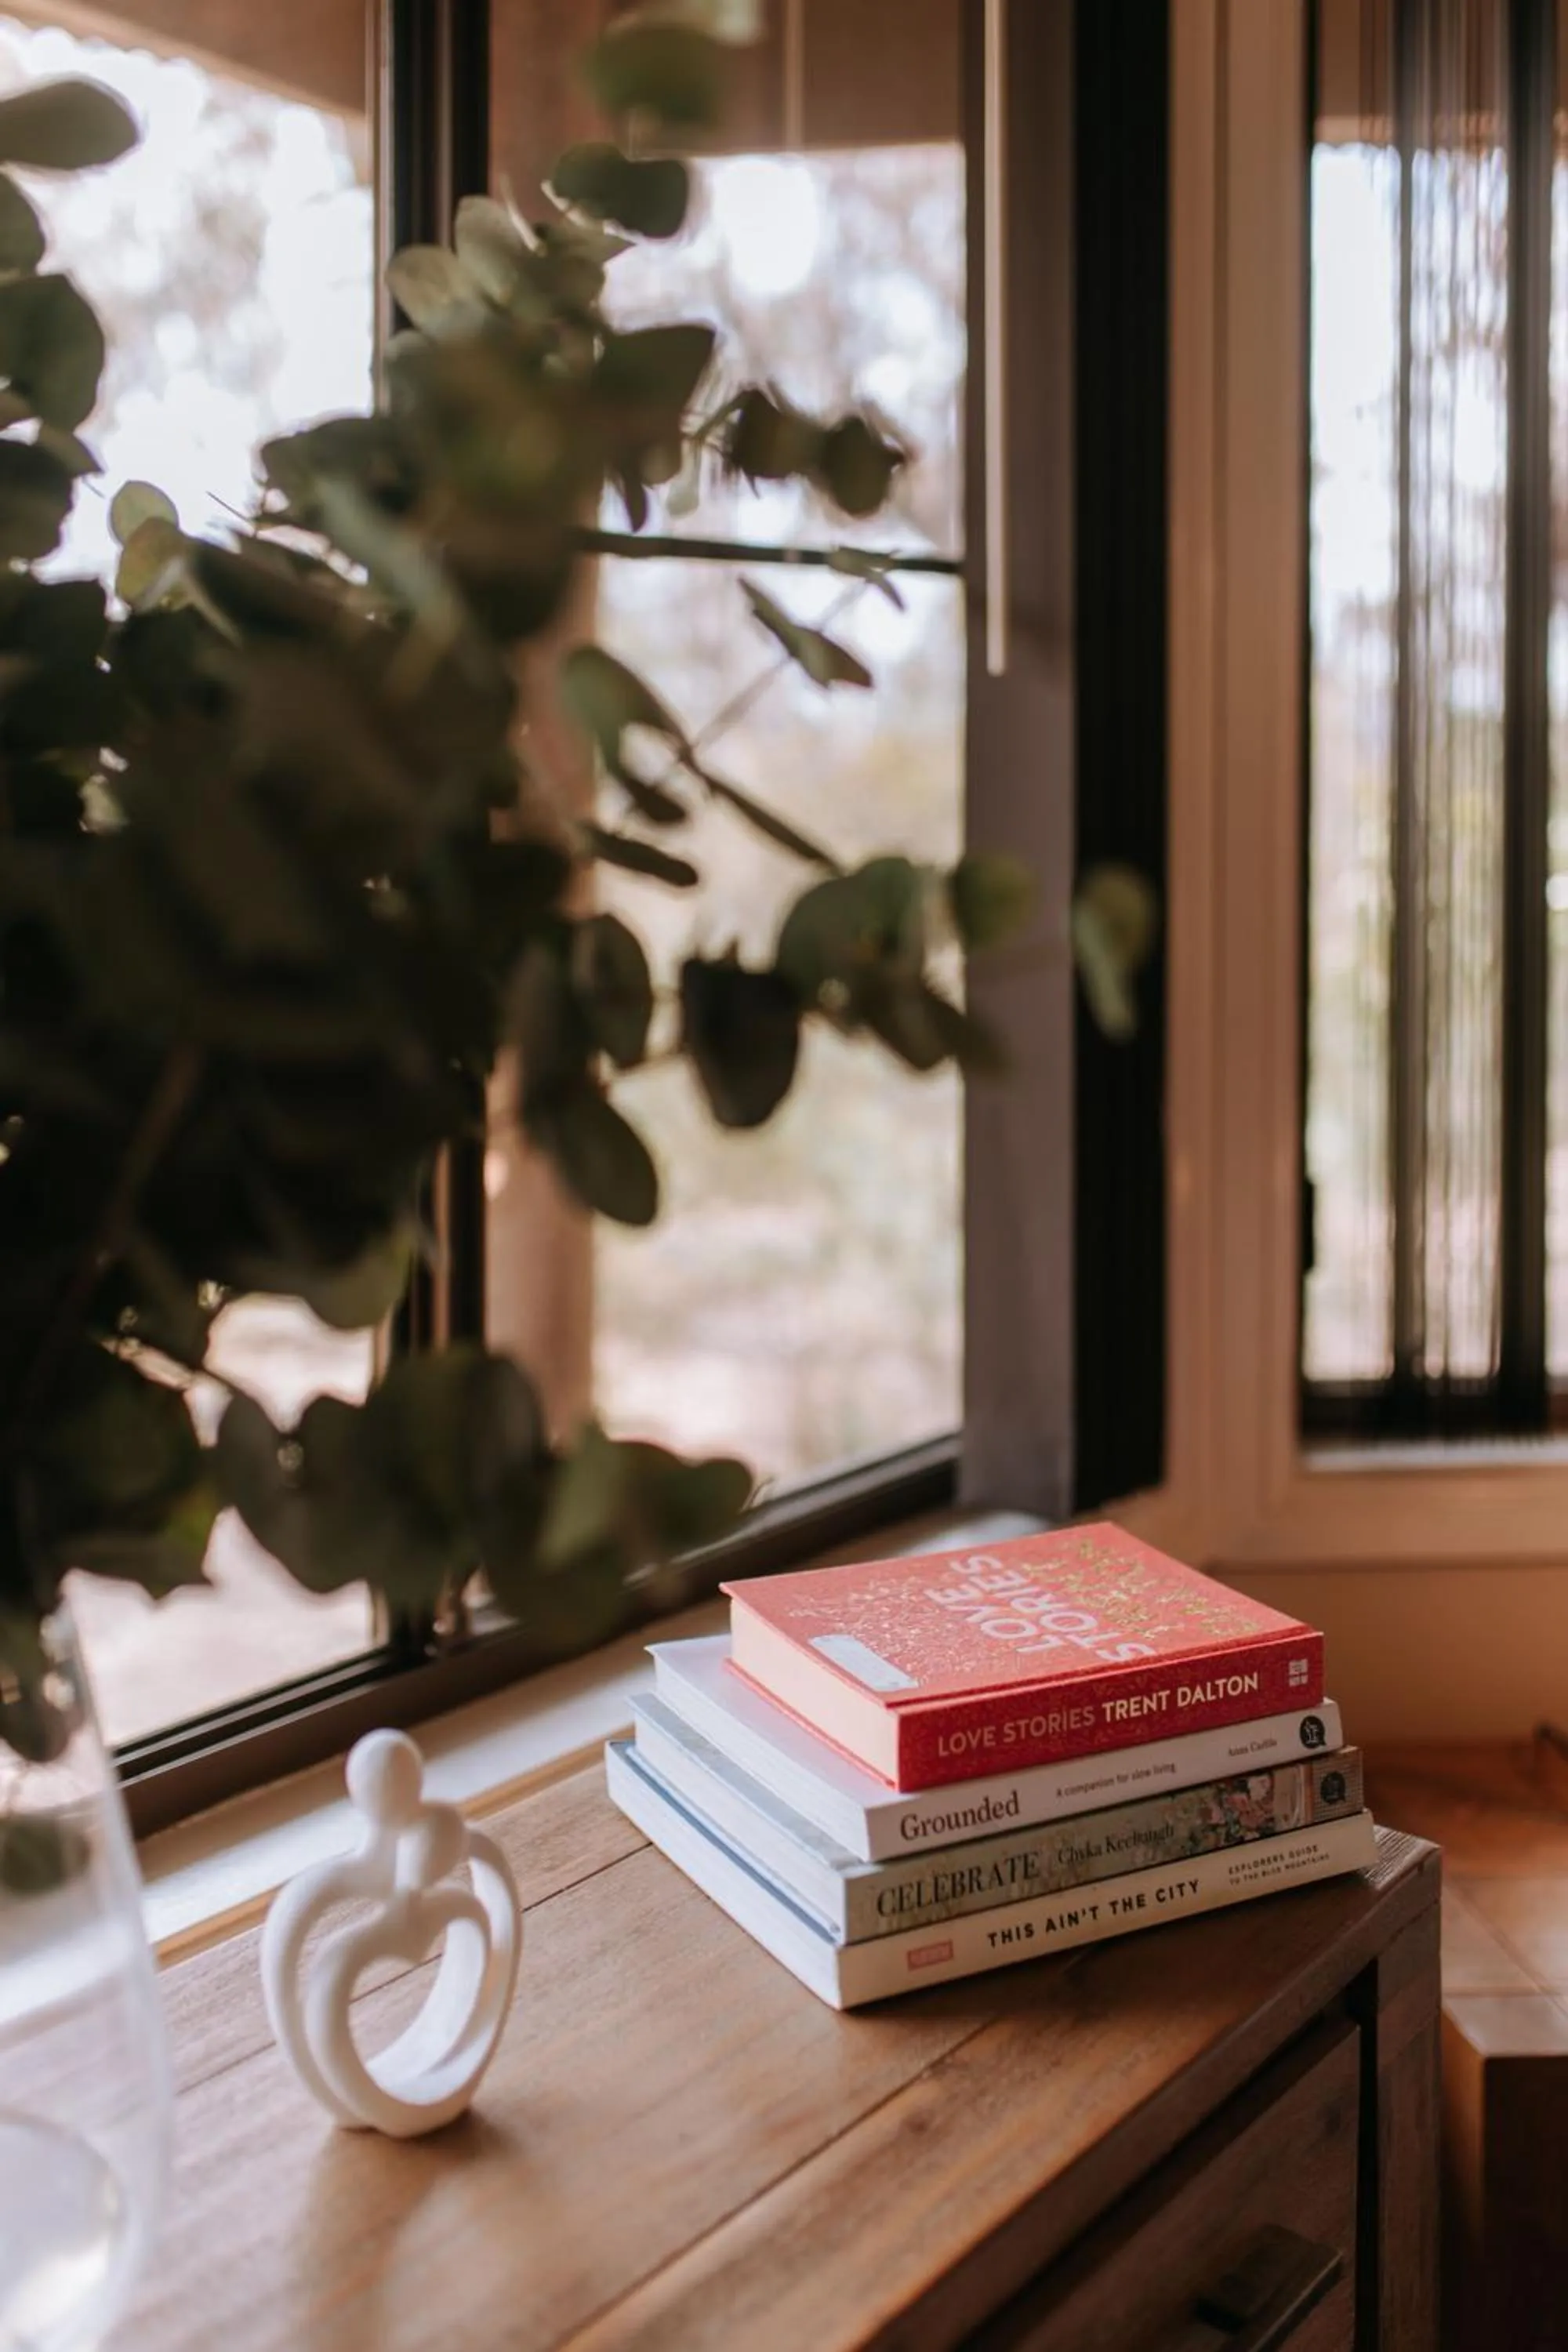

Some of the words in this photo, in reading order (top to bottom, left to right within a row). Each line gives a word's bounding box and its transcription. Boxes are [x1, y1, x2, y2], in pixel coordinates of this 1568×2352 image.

[924, 1583, 1063, 1653] LOVE
[949, 1555, 1157, 1662] STORIES
[938, 1726, 996, 1757] LOVE
[1002, 1706, 1095, 1743] STORIES
[1102, 1690, 1171, 1723] TRENT
[1177, 1671, 1258, 1708] DALTON
[900, 1789, 1020, 1841] Grounded
[877, 1850, 1040, 1918] CELEBRATE
[987, 1922, 1035, 1949] THIS
[1045, 1906, 1098, 1934] AIN'T
[1108, 1894, 1146, 1915] THE
[1155, 1880, 1200, 1903] CITY
